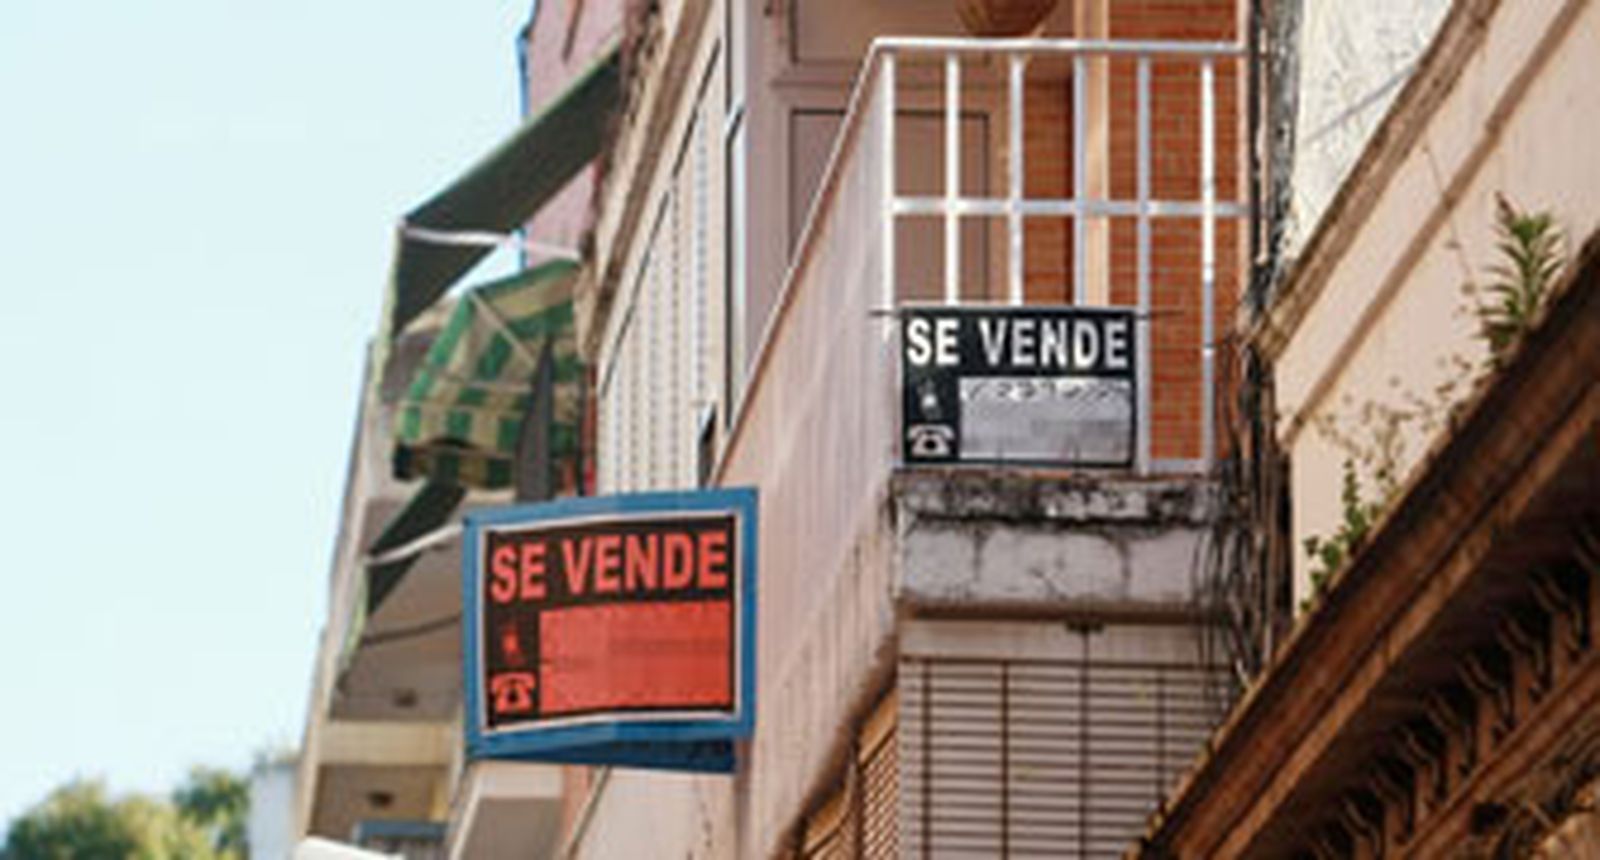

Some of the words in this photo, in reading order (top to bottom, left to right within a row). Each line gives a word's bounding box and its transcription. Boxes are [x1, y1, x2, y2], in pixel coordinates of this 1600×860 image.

[907, 318, 960, 367] SE
[979, 318, 1129, 368] VENDE
[491, 543, 547, 603] SE
[562, 531, 728, 595] VENDE
